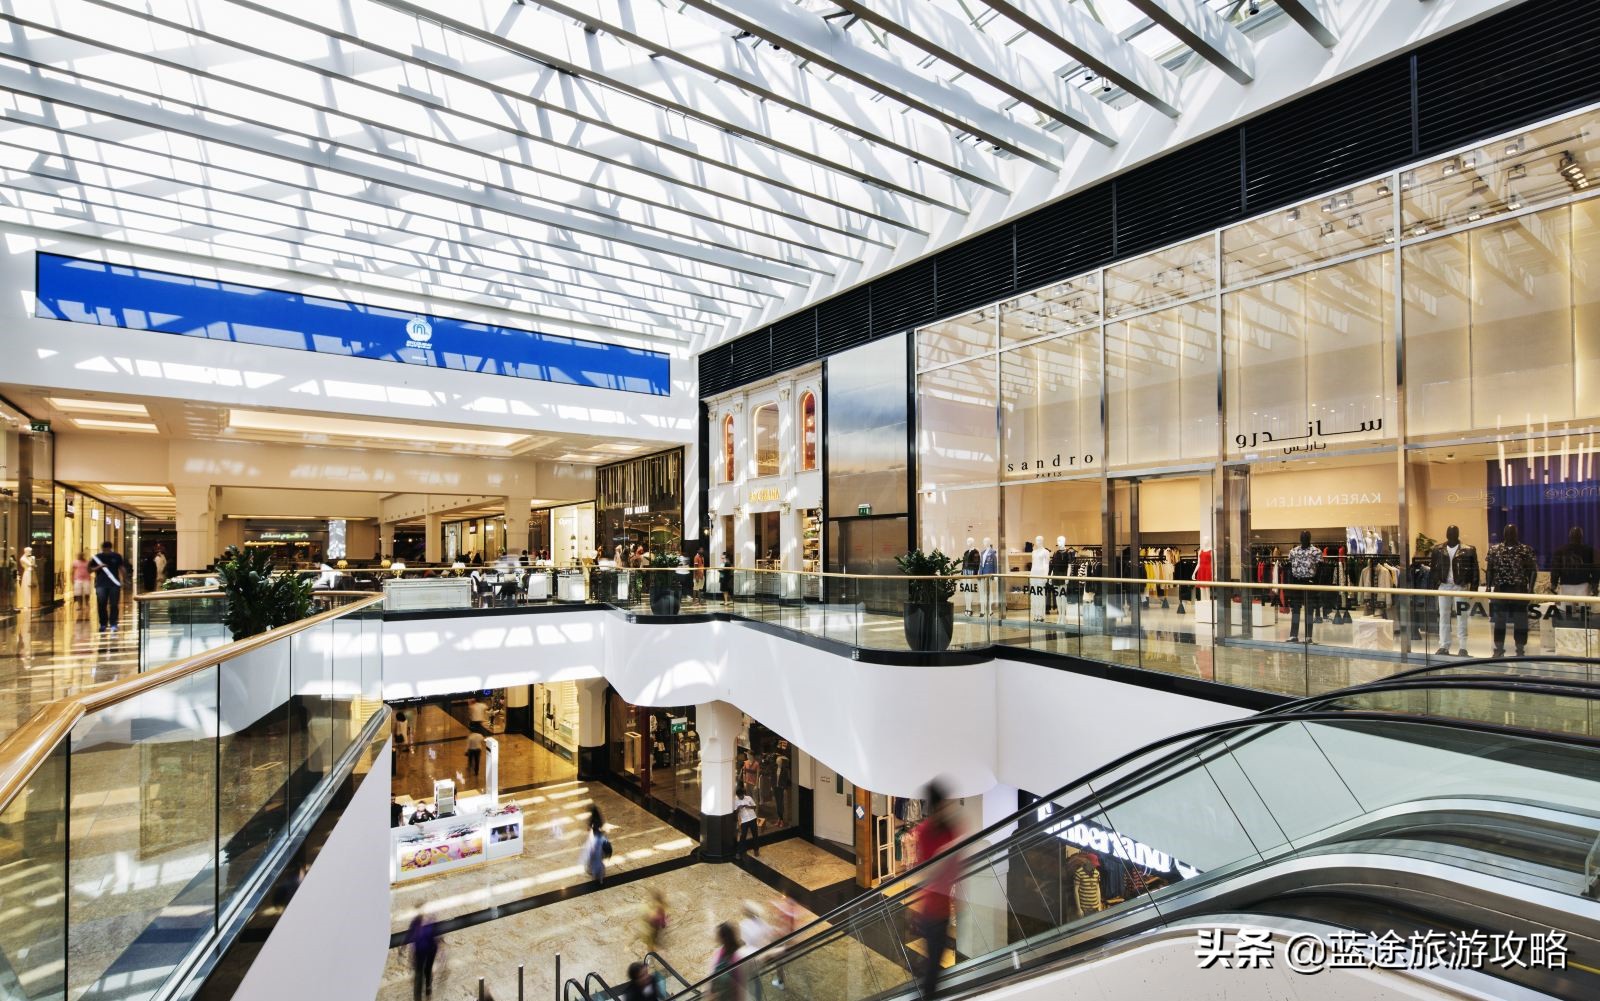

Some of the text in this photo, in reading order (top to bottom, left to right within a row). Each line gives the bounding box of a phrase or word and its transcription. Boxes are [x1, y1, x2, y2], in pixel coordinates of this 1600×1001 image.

[1235, 418, 1382, 448] ساندرو
[1283, 441, 1326, 454] باريس
[1007, 454, 1093, 472] sandro
[959, 583, 978, 593] SALE
